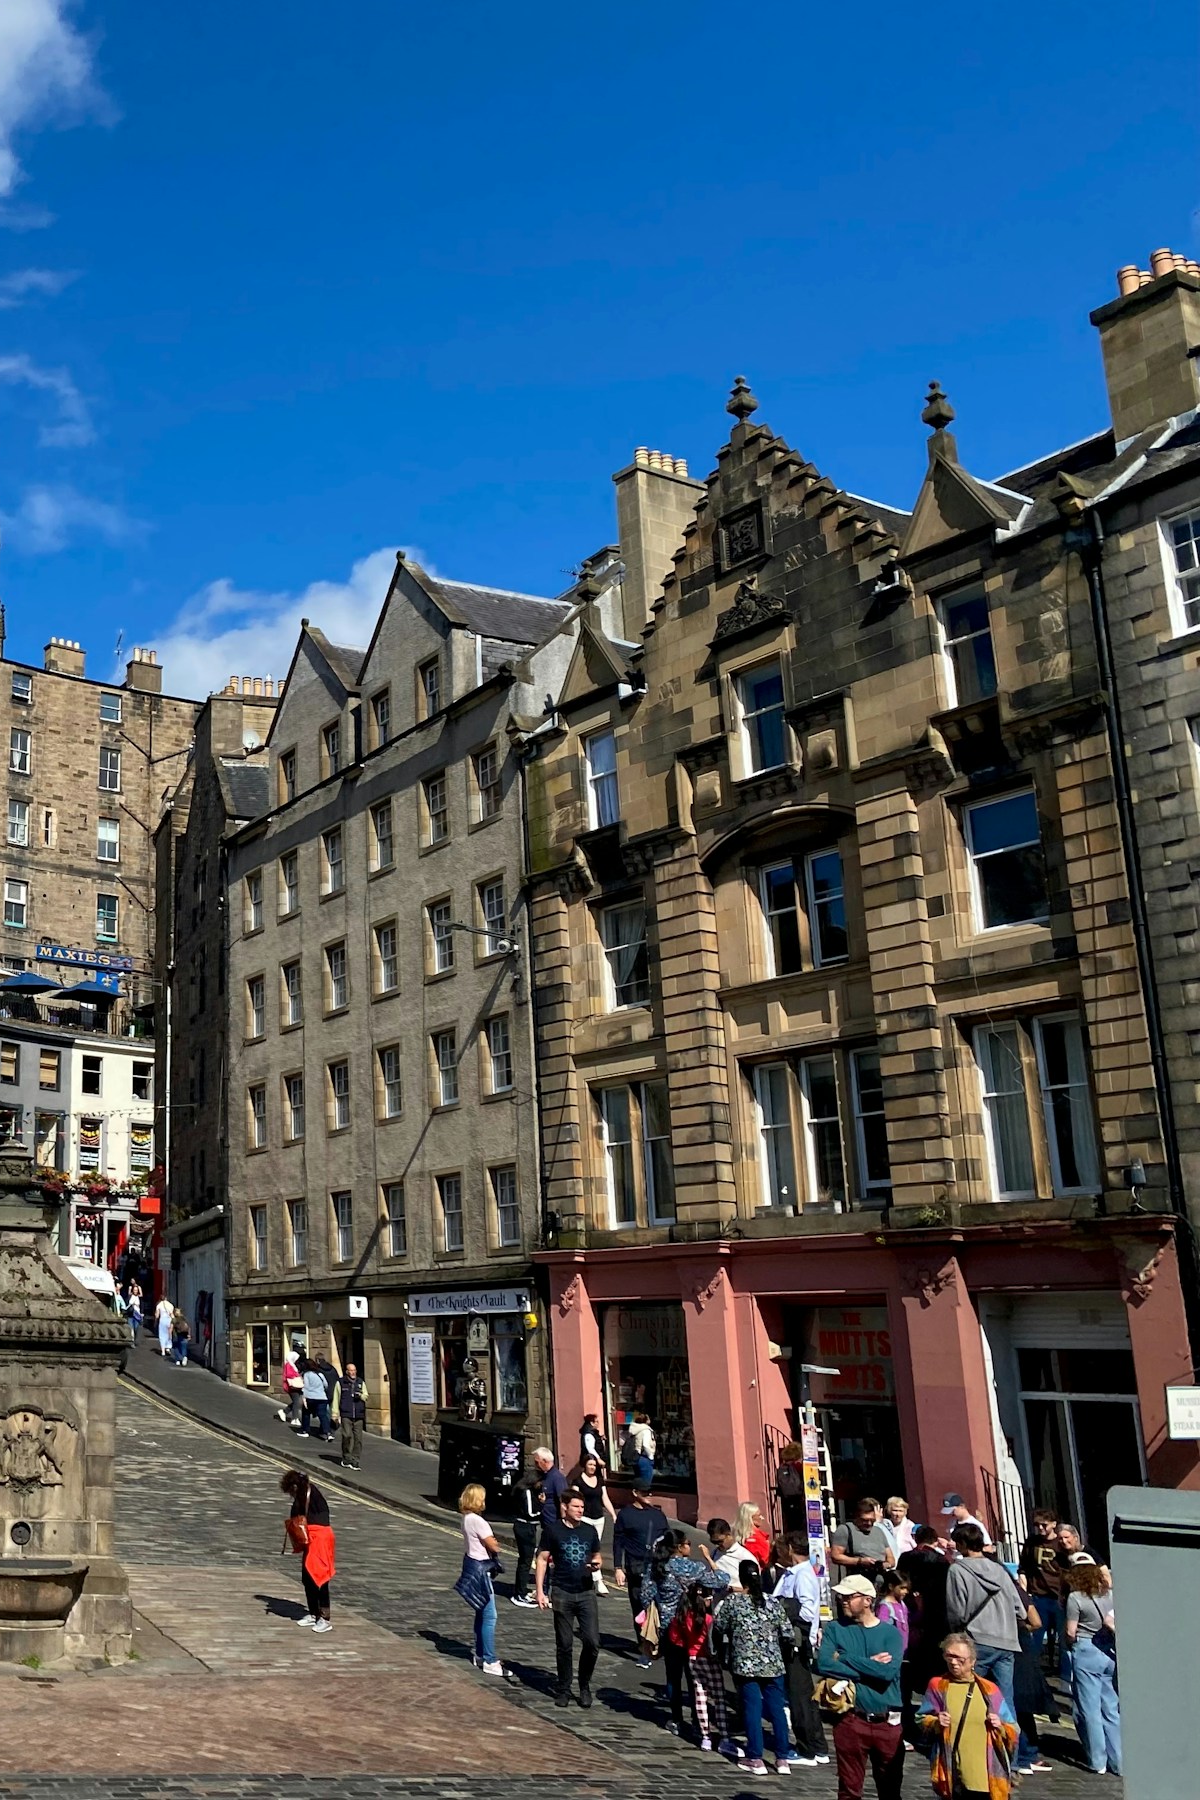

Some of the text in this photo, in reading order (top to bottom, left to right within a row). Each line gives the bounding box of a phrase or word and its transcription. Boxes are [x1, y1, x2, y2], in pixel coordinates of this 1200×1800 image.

[39, 946, 111, 965] MAXIES
[428, 1292, 506, 1311] The Knights Vault
[841, 1312, 862, 1326] THE
[649, 1330, 680, 1348] Sho
[818, 1330, 892, 1357] MUTTS
